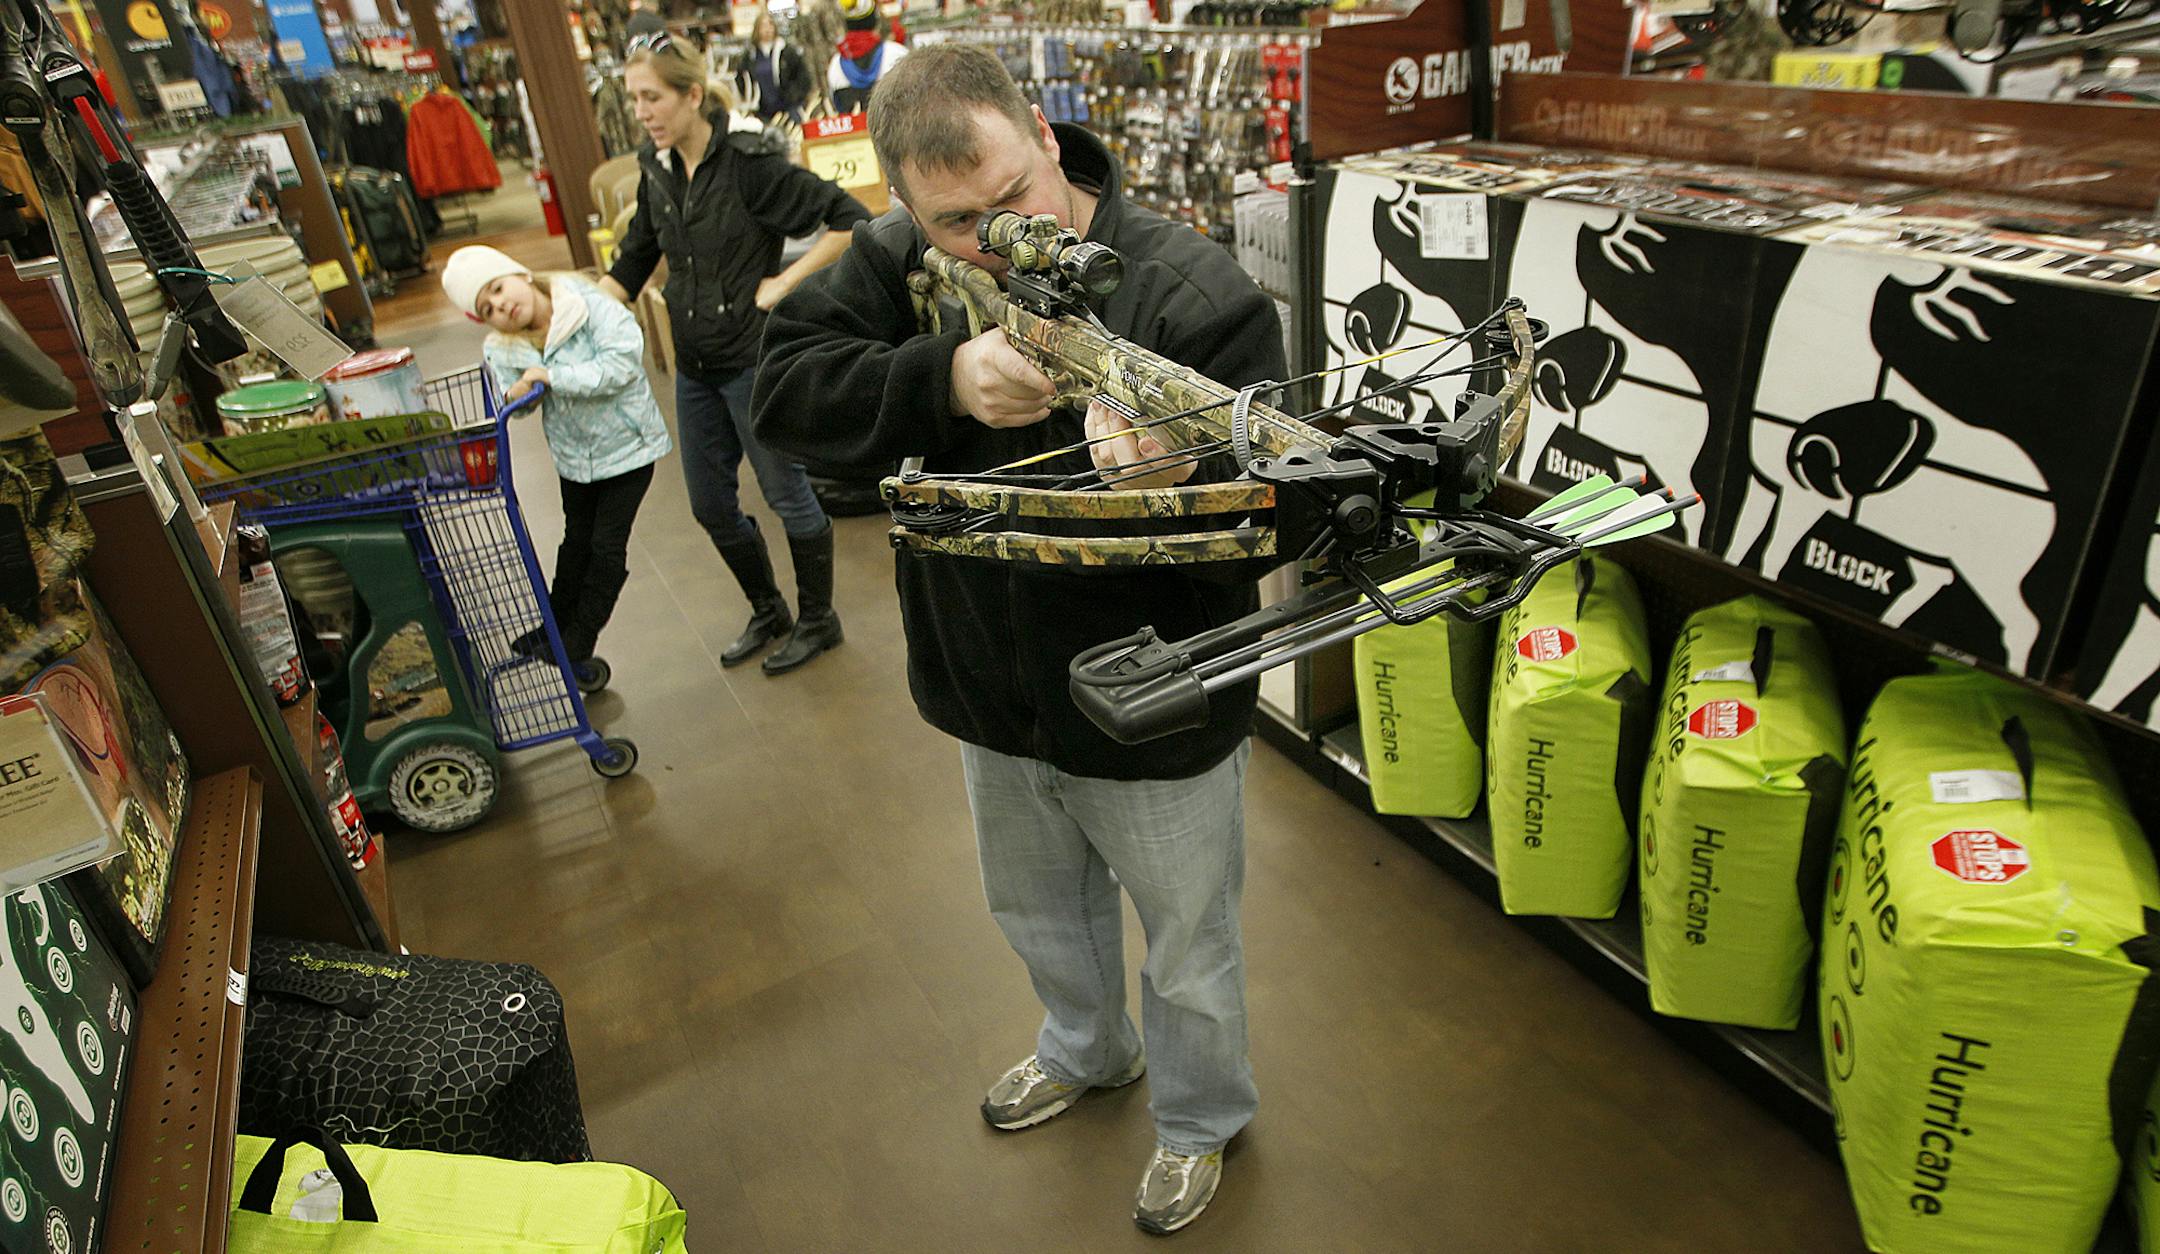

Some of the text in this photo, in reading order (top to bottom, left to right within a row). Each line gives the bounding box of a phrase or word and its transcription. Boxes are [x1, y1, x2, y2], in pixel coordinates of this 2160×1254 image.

[817, 114, 855, 137] SALE
[1360, 384, 1406, 422] BLOCK
[1804, 537, 1896, 595] BLOCK
[1544, 627, 1563, 661] STOPS
[1373, 660, 1402, 764] Hurricane
[1669, 622, 1705, 763] Hurricane
[1717, 701, 1740, 738] STOPS
[1525, 737, 1555, 849] Hurricane
[1685, 823, 1727, 945] Hurricane
[1966, 831, 2007, 881] STOPS
[1909, 1031, 1993, 1216] Hurricane
